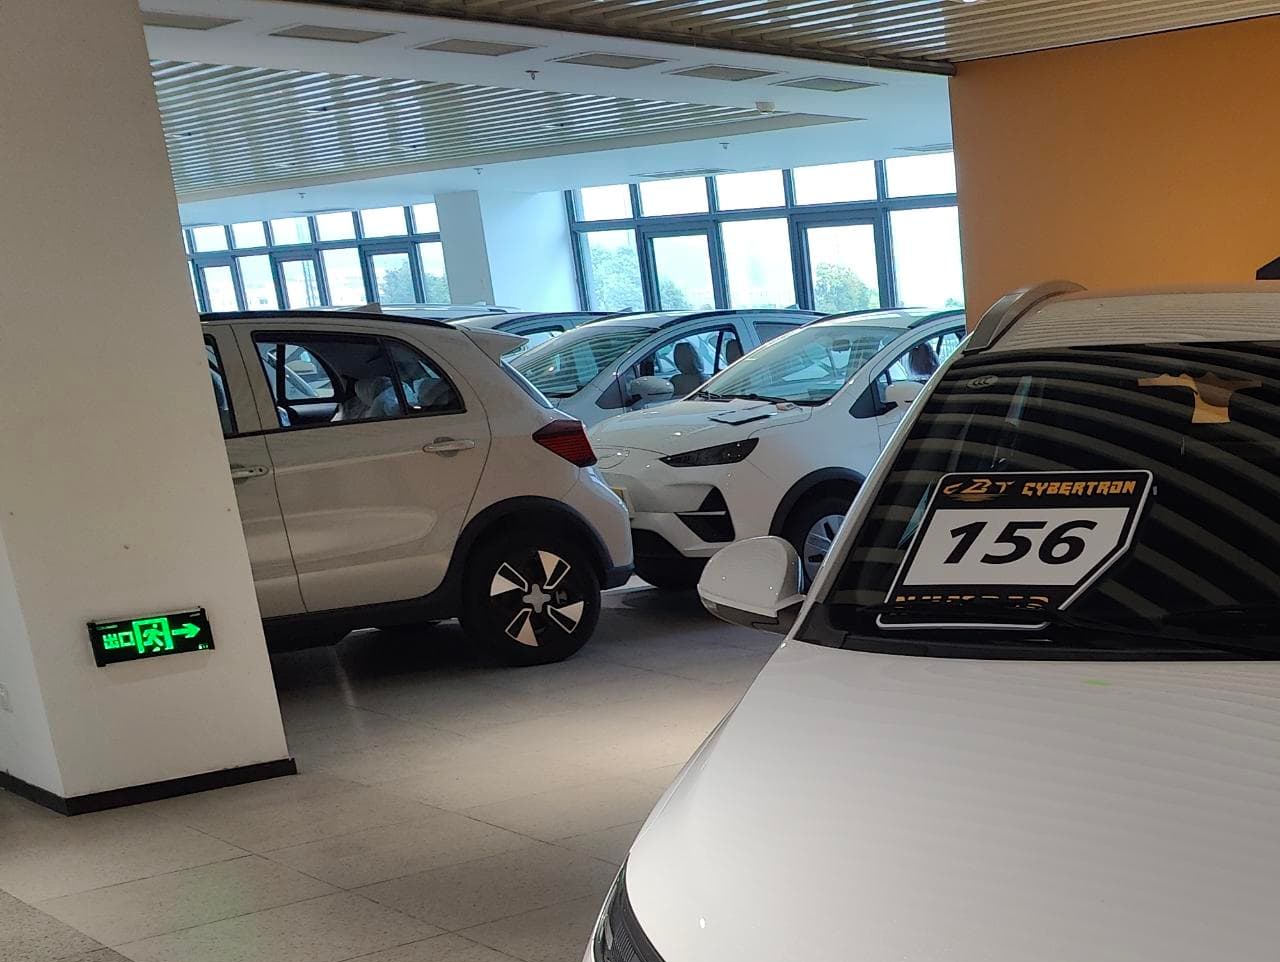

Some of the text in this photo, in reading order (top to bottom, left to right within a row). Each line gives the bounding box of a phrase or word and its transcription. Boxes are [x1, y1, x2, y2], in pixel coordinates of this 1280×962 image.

[1021, 481, 1137, 496] CYBERTRON
[943, 519, 1098, 565] 156
[102, 631, 136, 650] 出口
